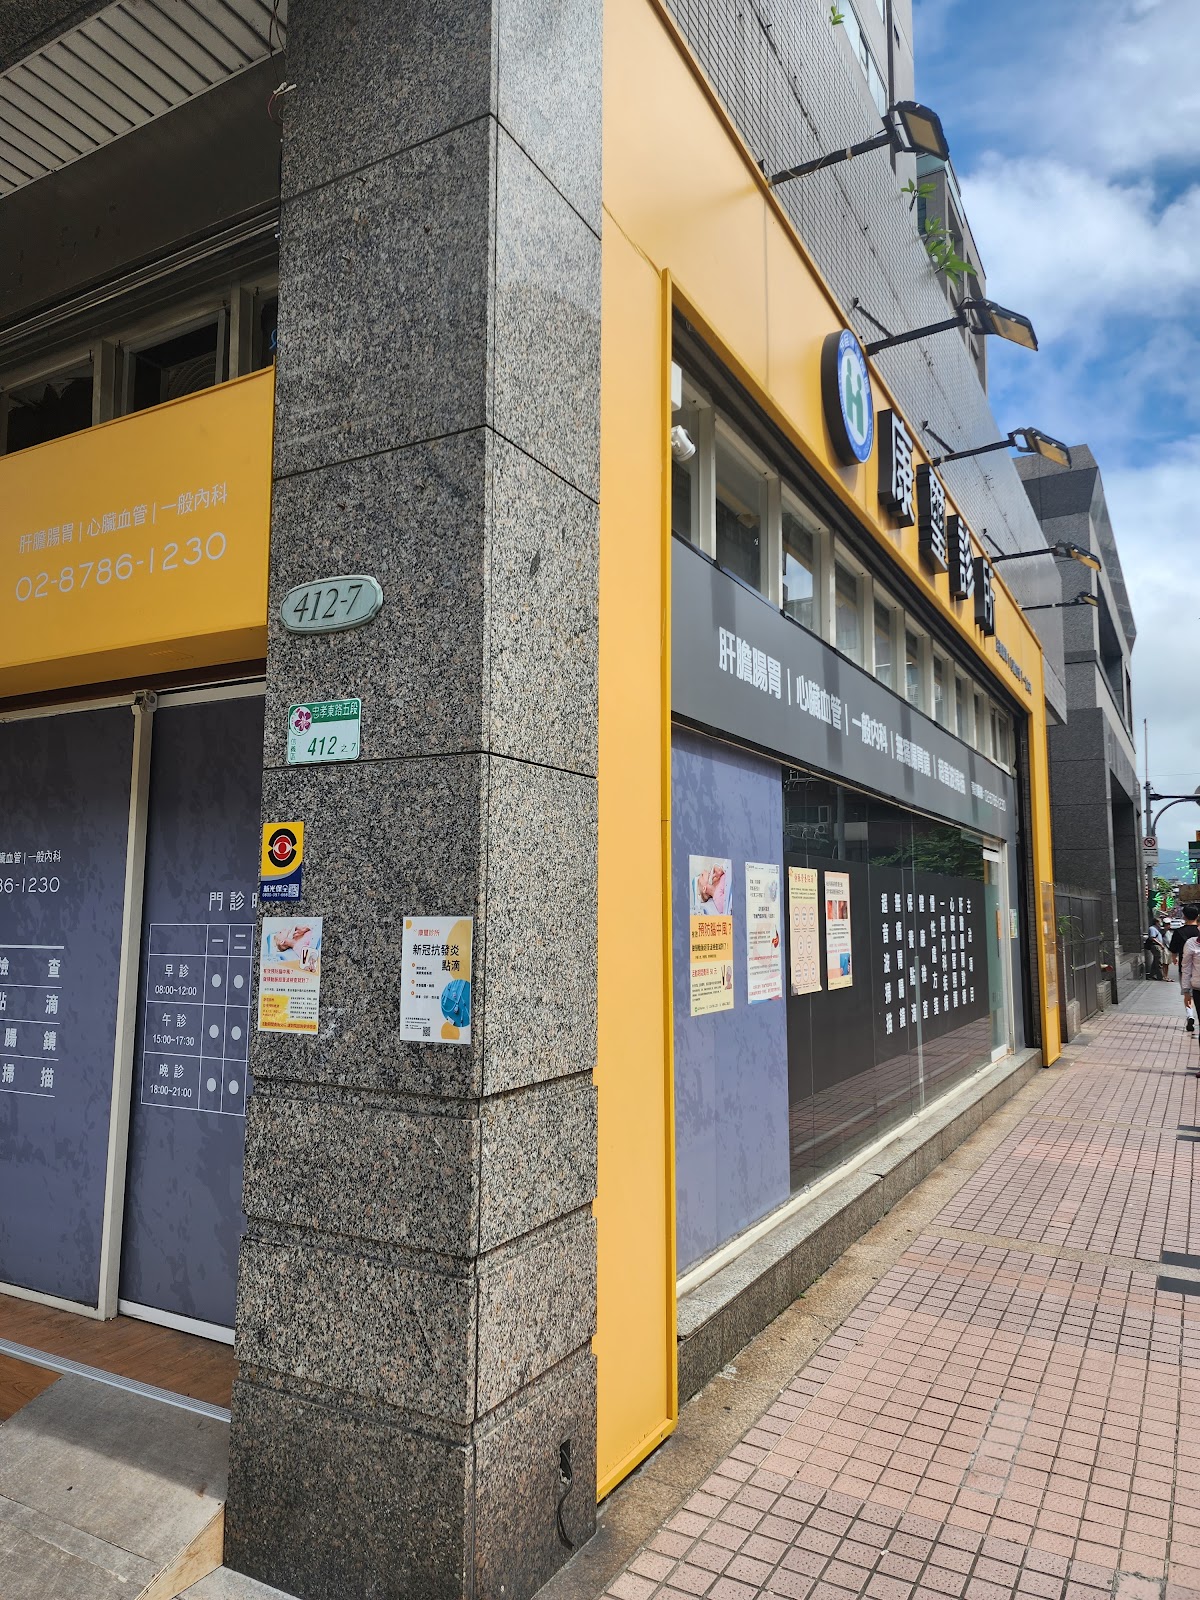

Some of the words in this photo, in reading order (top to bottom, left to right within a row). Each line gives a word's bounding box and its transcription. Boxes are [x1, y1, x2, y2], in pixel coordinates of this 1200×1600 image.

[19, 523, 74, 553] 肝膽腸胃
[86, 503, 148, 538] 心臟血管
[161, 481, 228, 515] 一般內科
[15, 531, 227, 602] 02-8786-1230
[293, 584, 363, 622] 412-7
[719, 626, 782, 699] 肝膽腸胃
[796, 675, 842, 730] 心臟血管
[852, 711, 888, 754] 一般內科
[312, 701, 358, 719] 忠孝東路五段
[307, 736, 338, 756] 412
[28, 850, 61, 863] 一般內科
[412, 943, 460, 957] 新冠抗發炎
[164, 963, 189, 978] 早診
[441, 959, 461, 972] 點滴
[162, 1012, 187, 1028] 午診
[159, 1063, 184, 1079] 晚診
